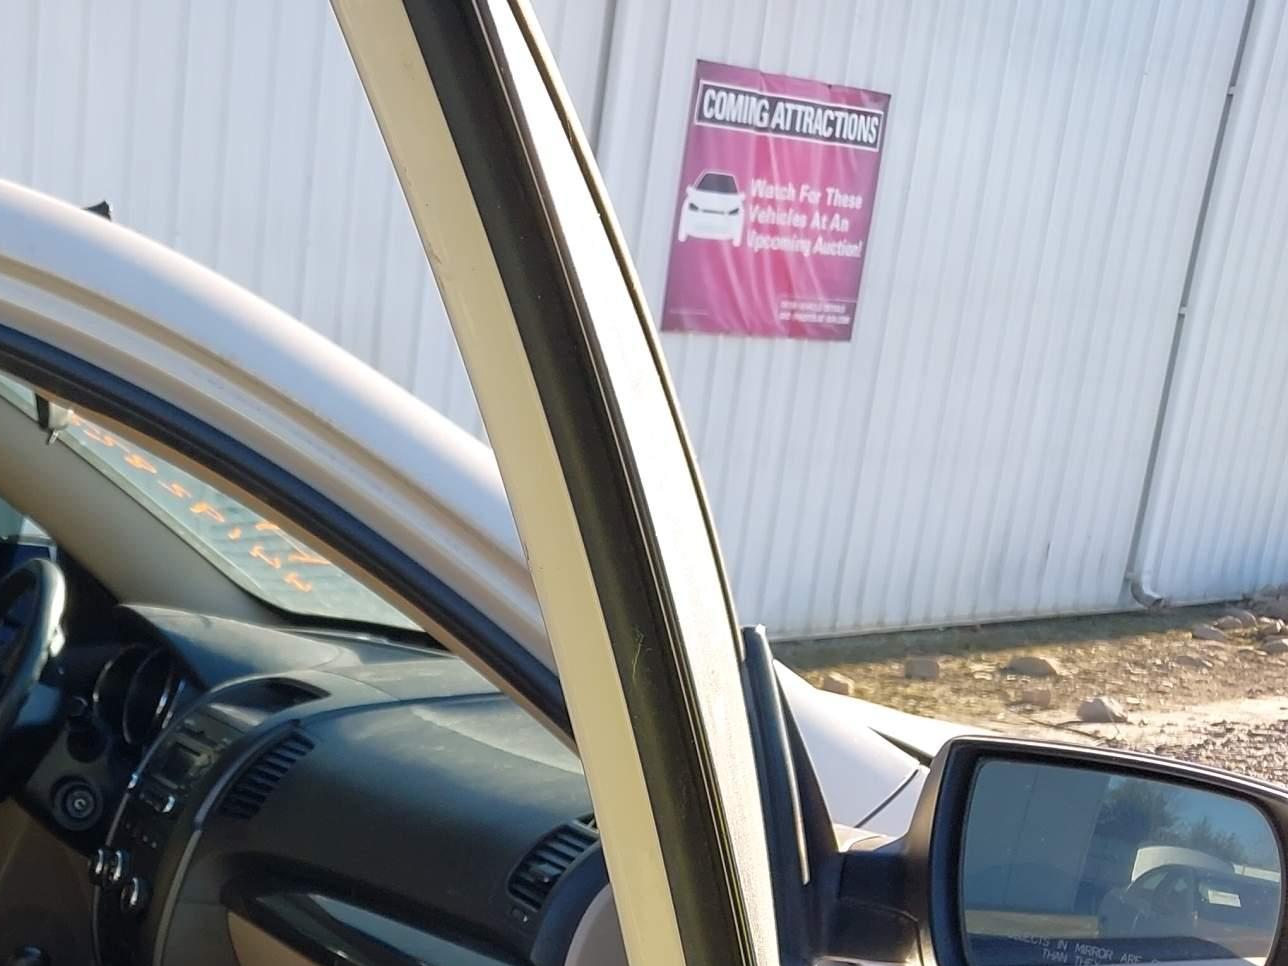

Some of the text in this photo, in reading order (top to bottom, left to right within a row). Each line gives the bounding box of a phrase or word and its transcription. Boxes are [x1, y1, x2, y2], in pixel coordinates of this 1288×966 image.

[703, 89, 879, 144] COMING ATTRACTIONS
[751, 178, 862, 210] Watch For These
[748, 203, 850, 232] Vehicles At An
[746, 229, 812, 257] Upcoming
[1042, 948, 1068, 963] THAN
[1074, 943, 1114, 961] MIRROR
